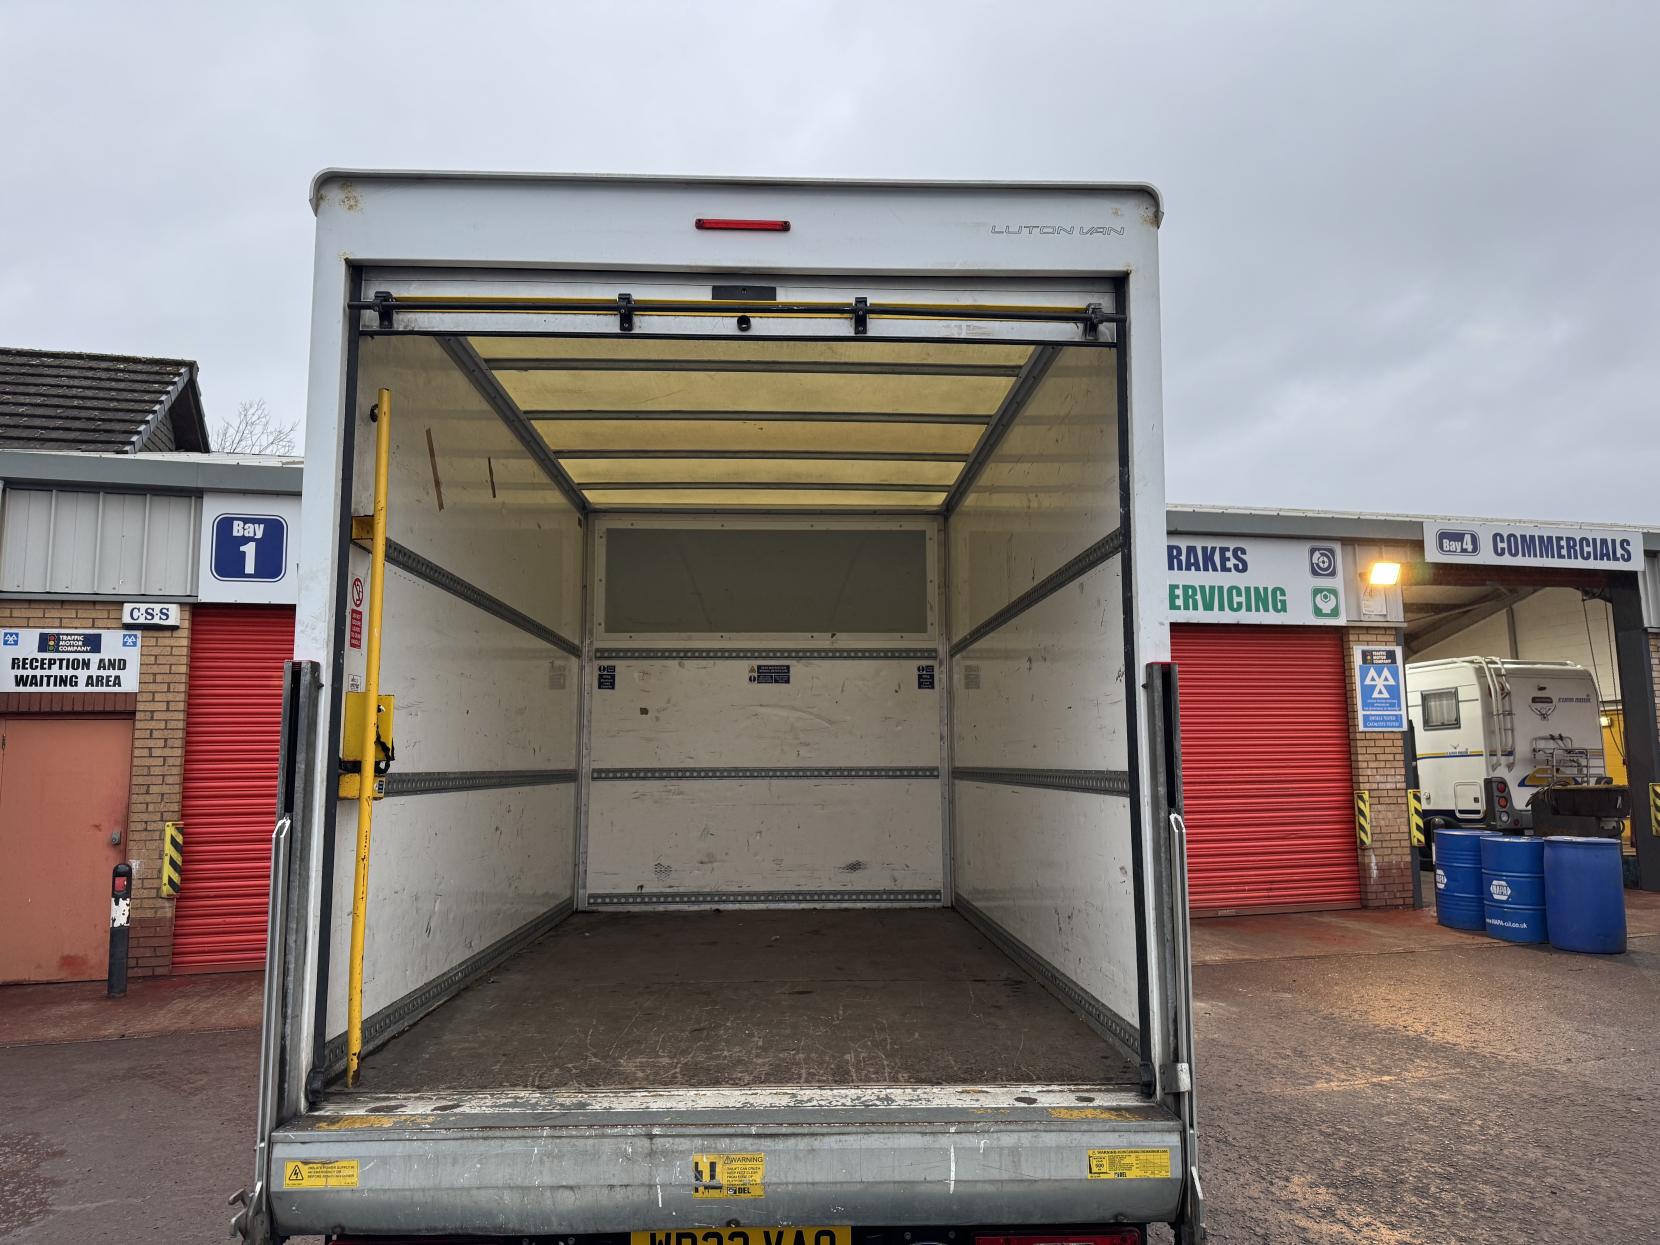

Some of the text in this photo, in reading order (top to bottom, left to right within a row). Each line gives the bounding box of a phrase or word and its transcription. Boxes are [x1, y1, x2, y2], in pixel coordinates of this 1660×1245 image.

[991, 225, 1125, 236] LUTON VAN
[232, 520, 265, 539] Bay
[1442, 534, 1473, 553] Bay 4
[1491, 532, 1632, 563] COMMERCIALS
[239, 541, 256, 574] 1
[1167, 544, 1249, 574] RAKES
[1168, 583, 1288, 613] ERVICING
[11, 657, 127, 671] RECEPTION AND
[14, 674, 122, 688] WAITING AREA
[1491, 884, 1509, 896] NAPA
